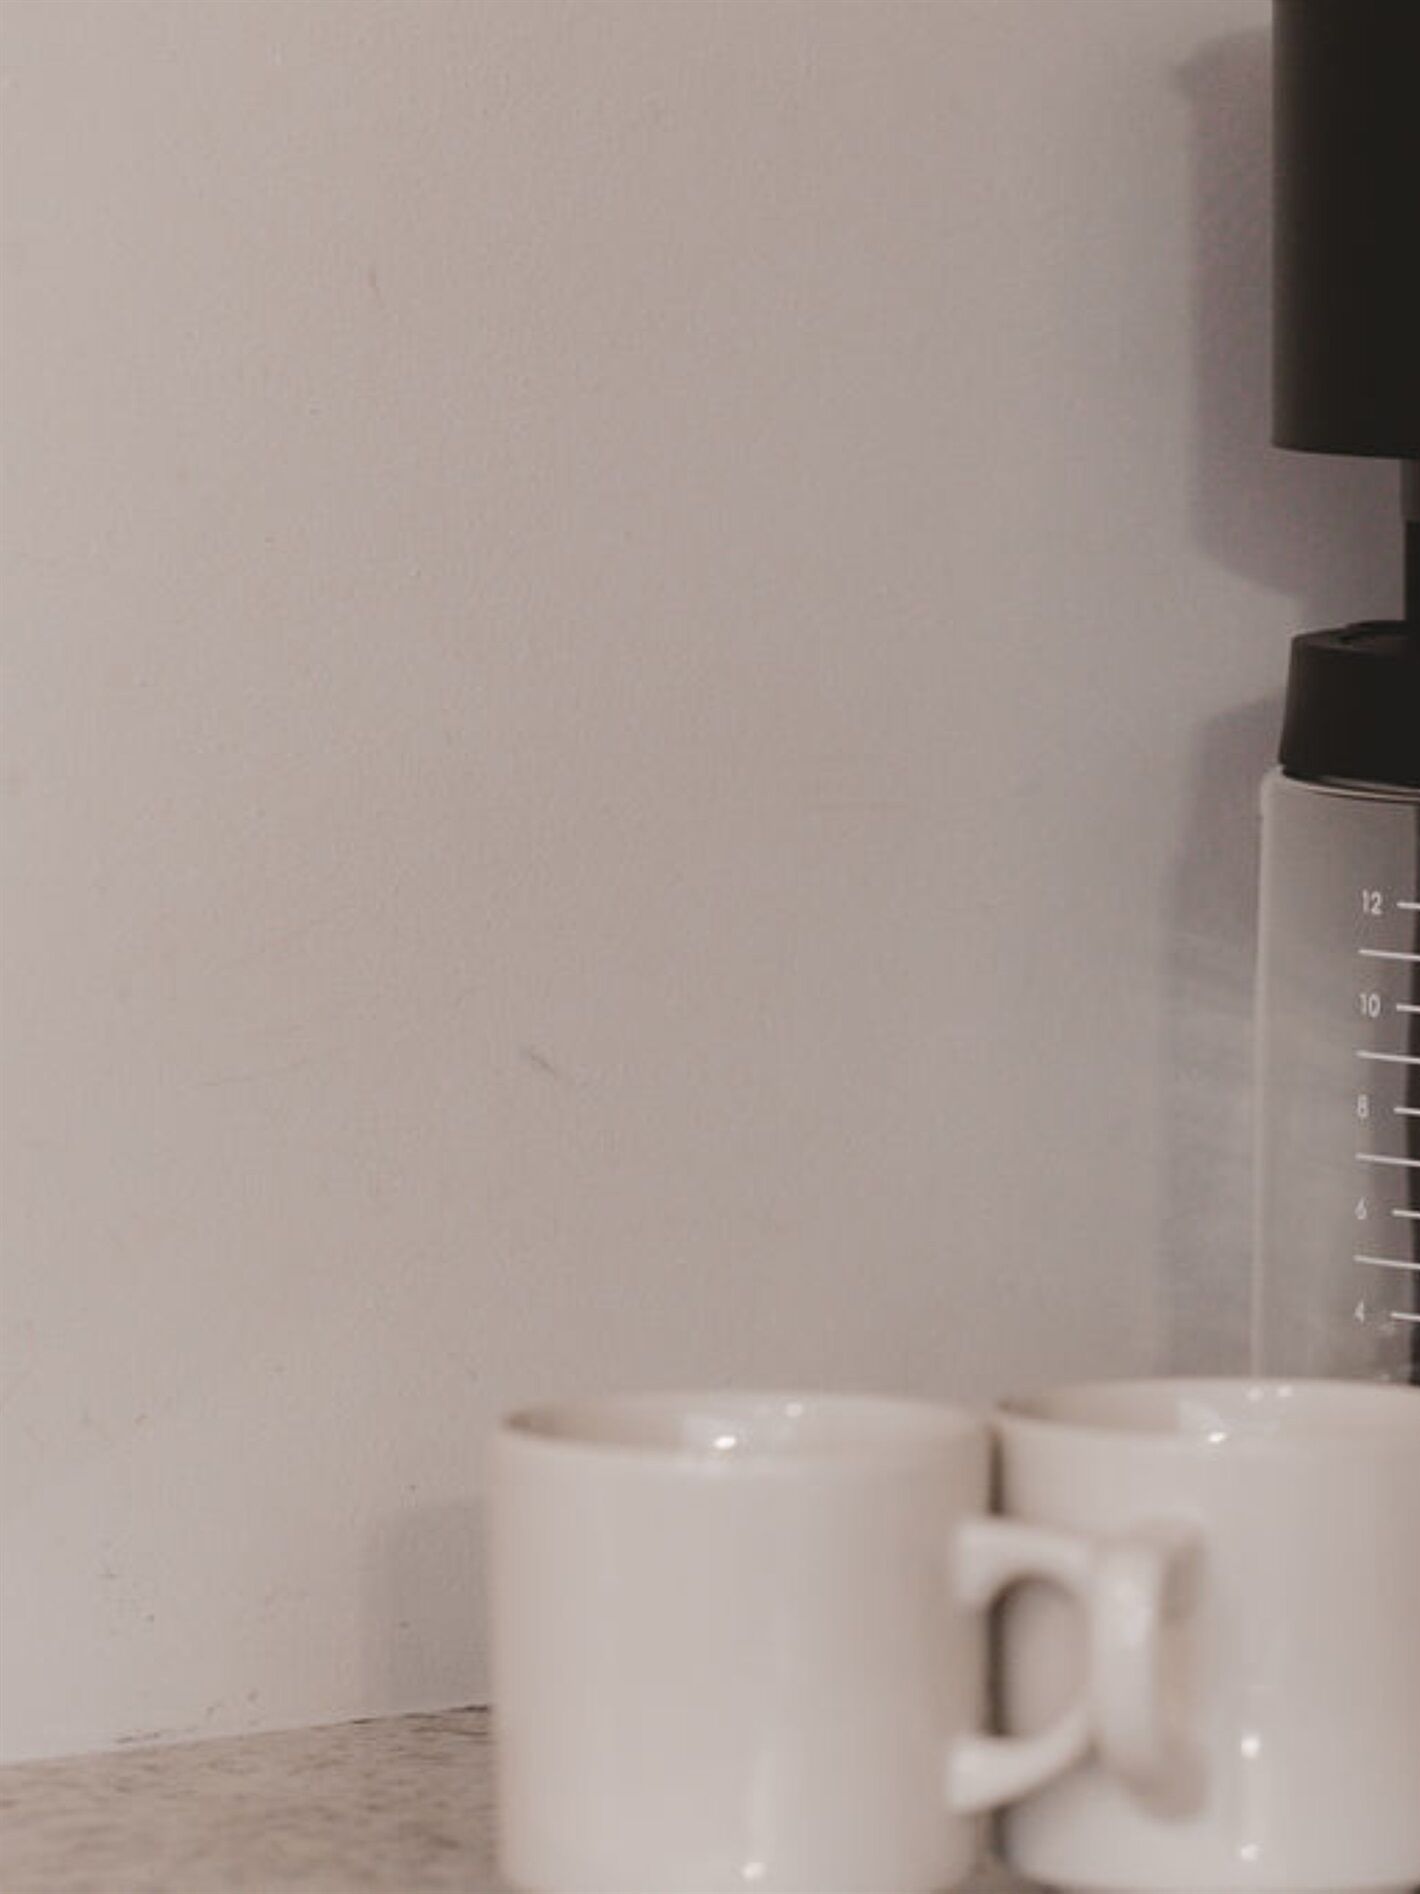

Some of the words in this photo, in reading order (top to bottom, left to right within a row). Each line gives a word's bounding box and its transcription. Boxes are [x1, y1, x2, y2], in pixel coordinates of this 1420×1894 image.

[1361, 889, 1383, 915] 12
[1360, 993, 1381, 1018] 10
[1356, 1094, 1369, 1119] 8
[1354, 1196, 1368, 1221] 6
[1353, 1300, 1364, 1324] 4
